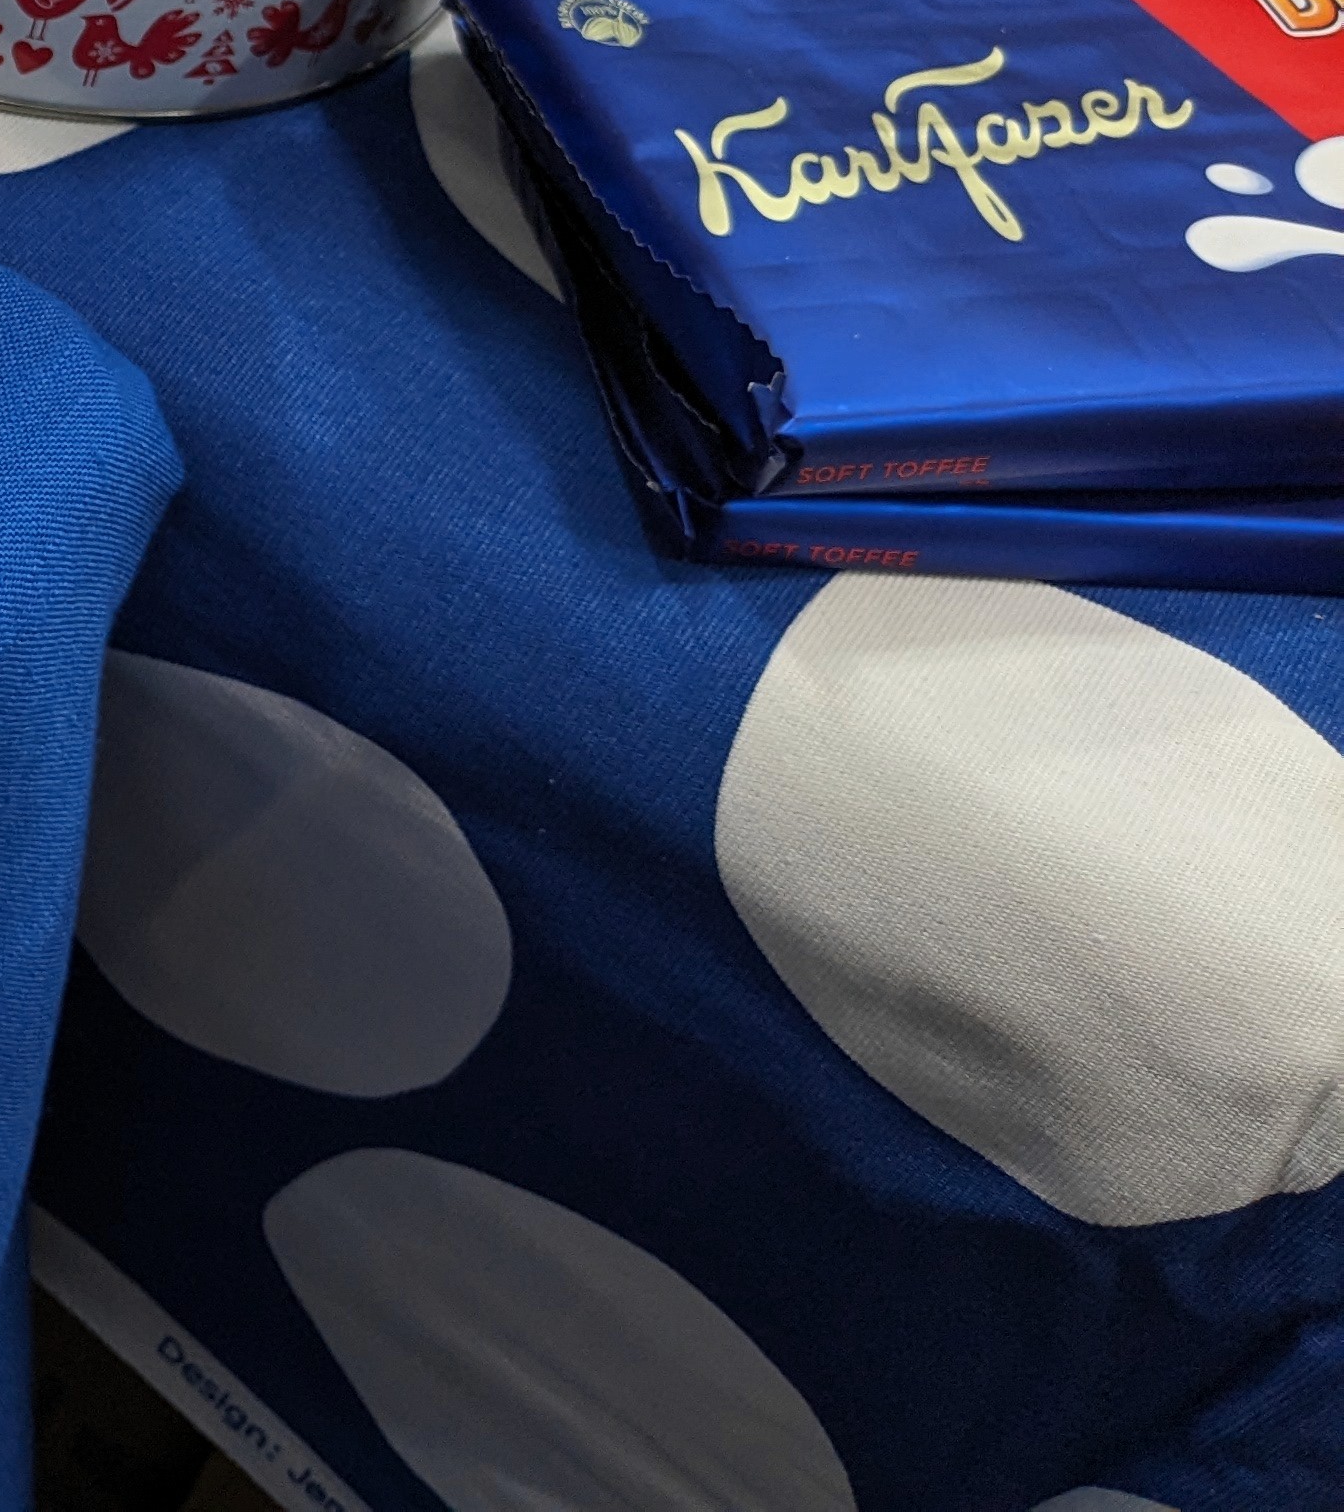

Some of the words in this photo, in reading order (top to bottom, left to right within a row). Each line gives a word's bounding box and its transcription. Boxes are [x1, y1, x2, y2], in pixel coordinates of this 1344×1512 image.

[796, 463, 874, 486] SOFT
[883, 455, 992, 481] TOFFEE
[808, 545, 921, 568] TOFFEE
[157, 1335, 282, 1463] Design:
